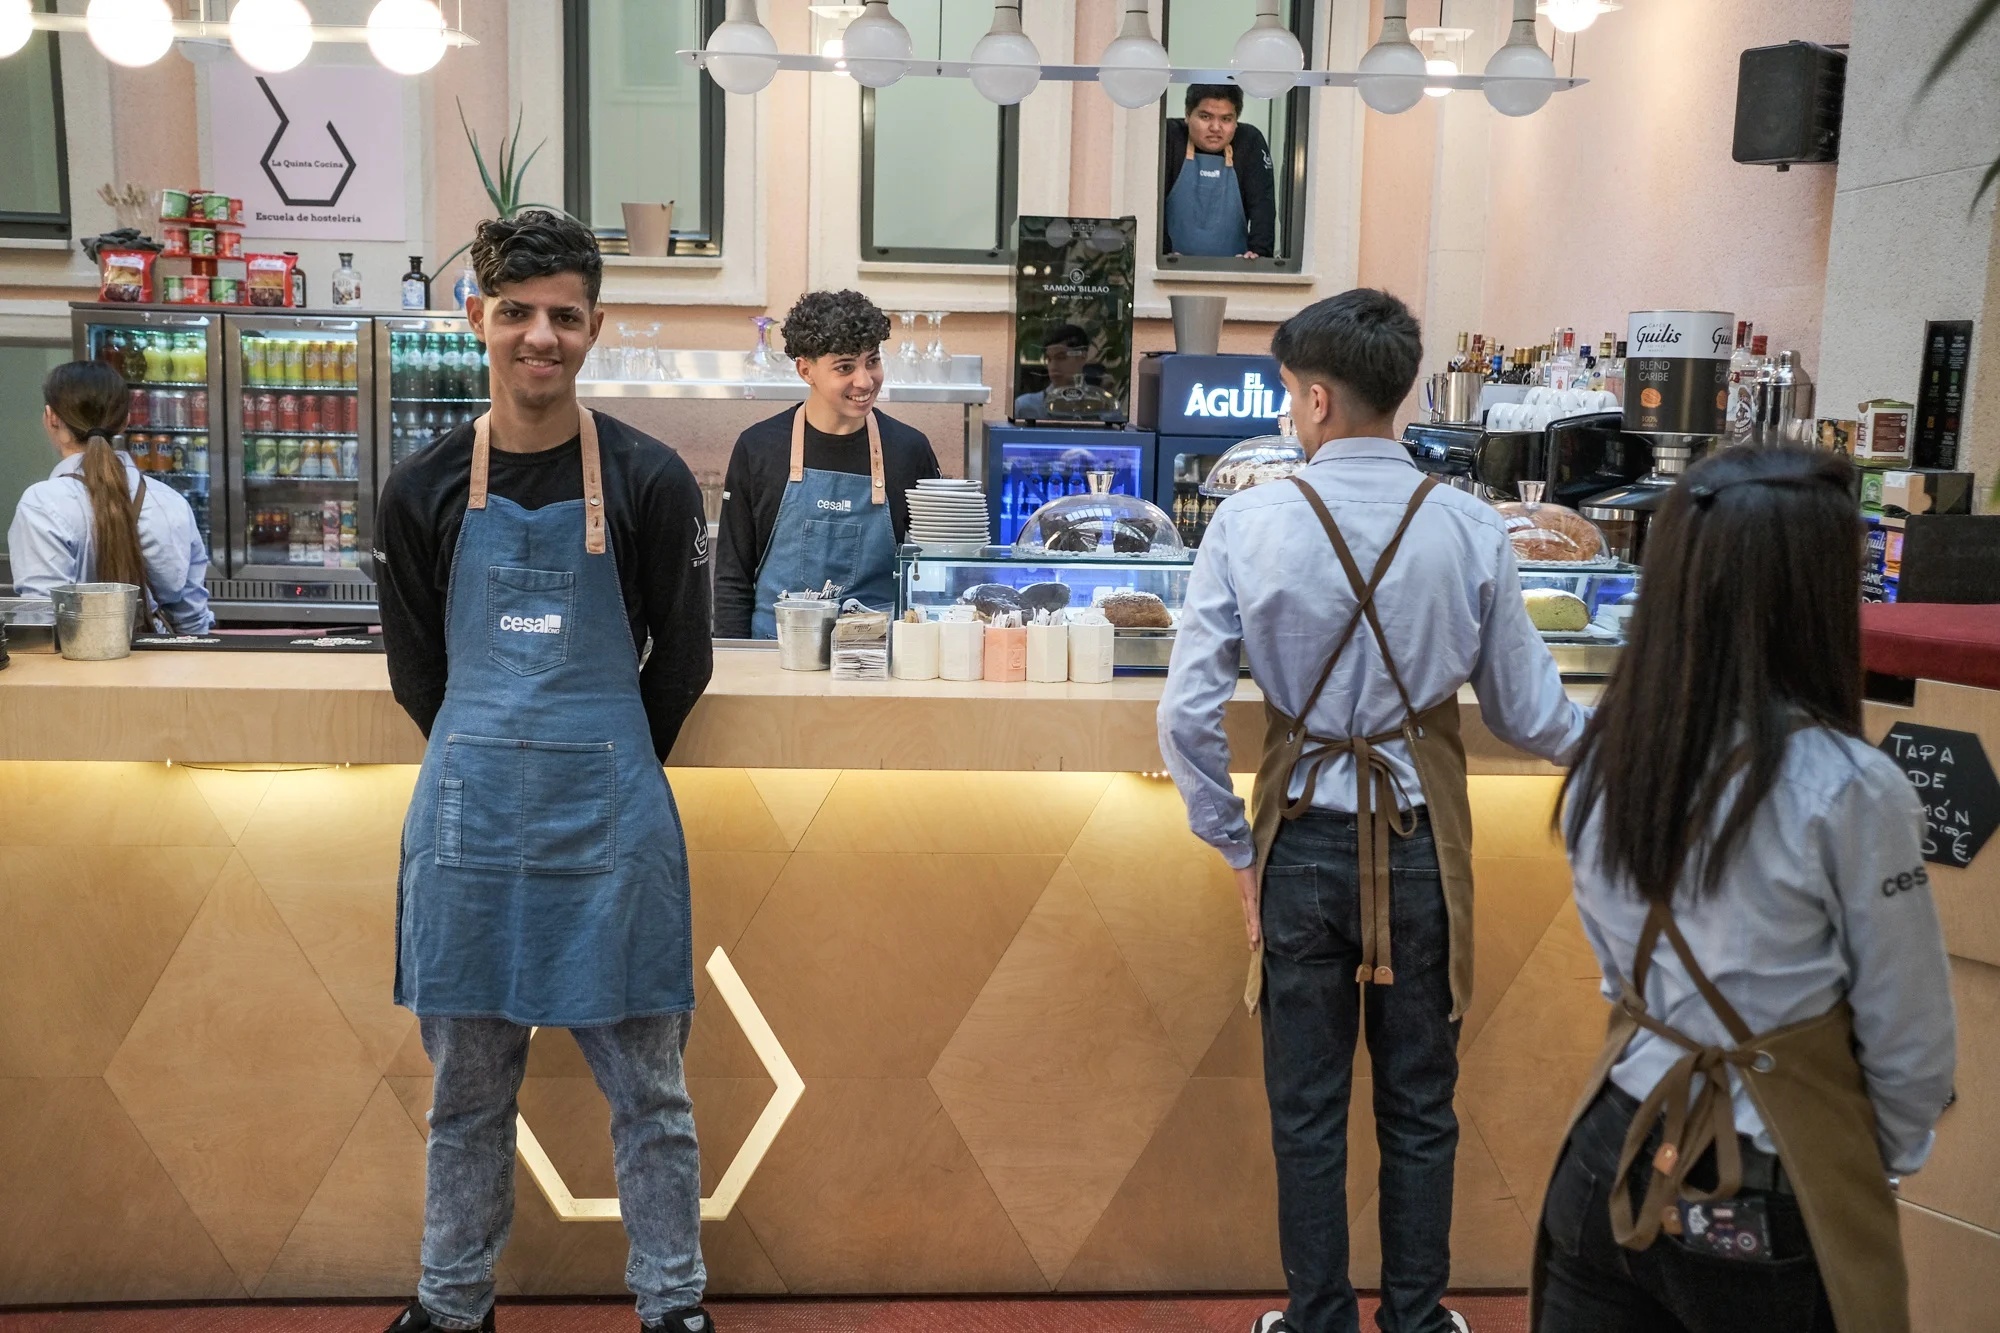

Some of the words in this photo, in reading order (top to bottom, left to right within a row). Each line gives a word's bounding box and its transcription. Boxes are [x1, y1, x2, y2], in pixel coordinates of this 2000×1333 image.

[283, 160, 313, 168] Quinta
[314, 160, 344, 168] Cocina
[255, 212, 294, 221] Escuela
[297, 212, 309, 221] de
[1042, 283, 1076, 293] RAMÓN
[1077, 285, 1110, 294] BILBAO
[1636, 323, 1682, 352] Guilis
[1640, 361, 1671, 371] BLEND
[1244, 372, 1265, 389] EL
[1638, 372, 1669, 382] CARIBE
[816, 499, 845, 512] cesal
[500, 614, 549, 634] cesal
[1890, 733, 1955, 765] TAPA
[1907, 769, 1947, 789] DE
[1882, 866, 1929, 897] ces
